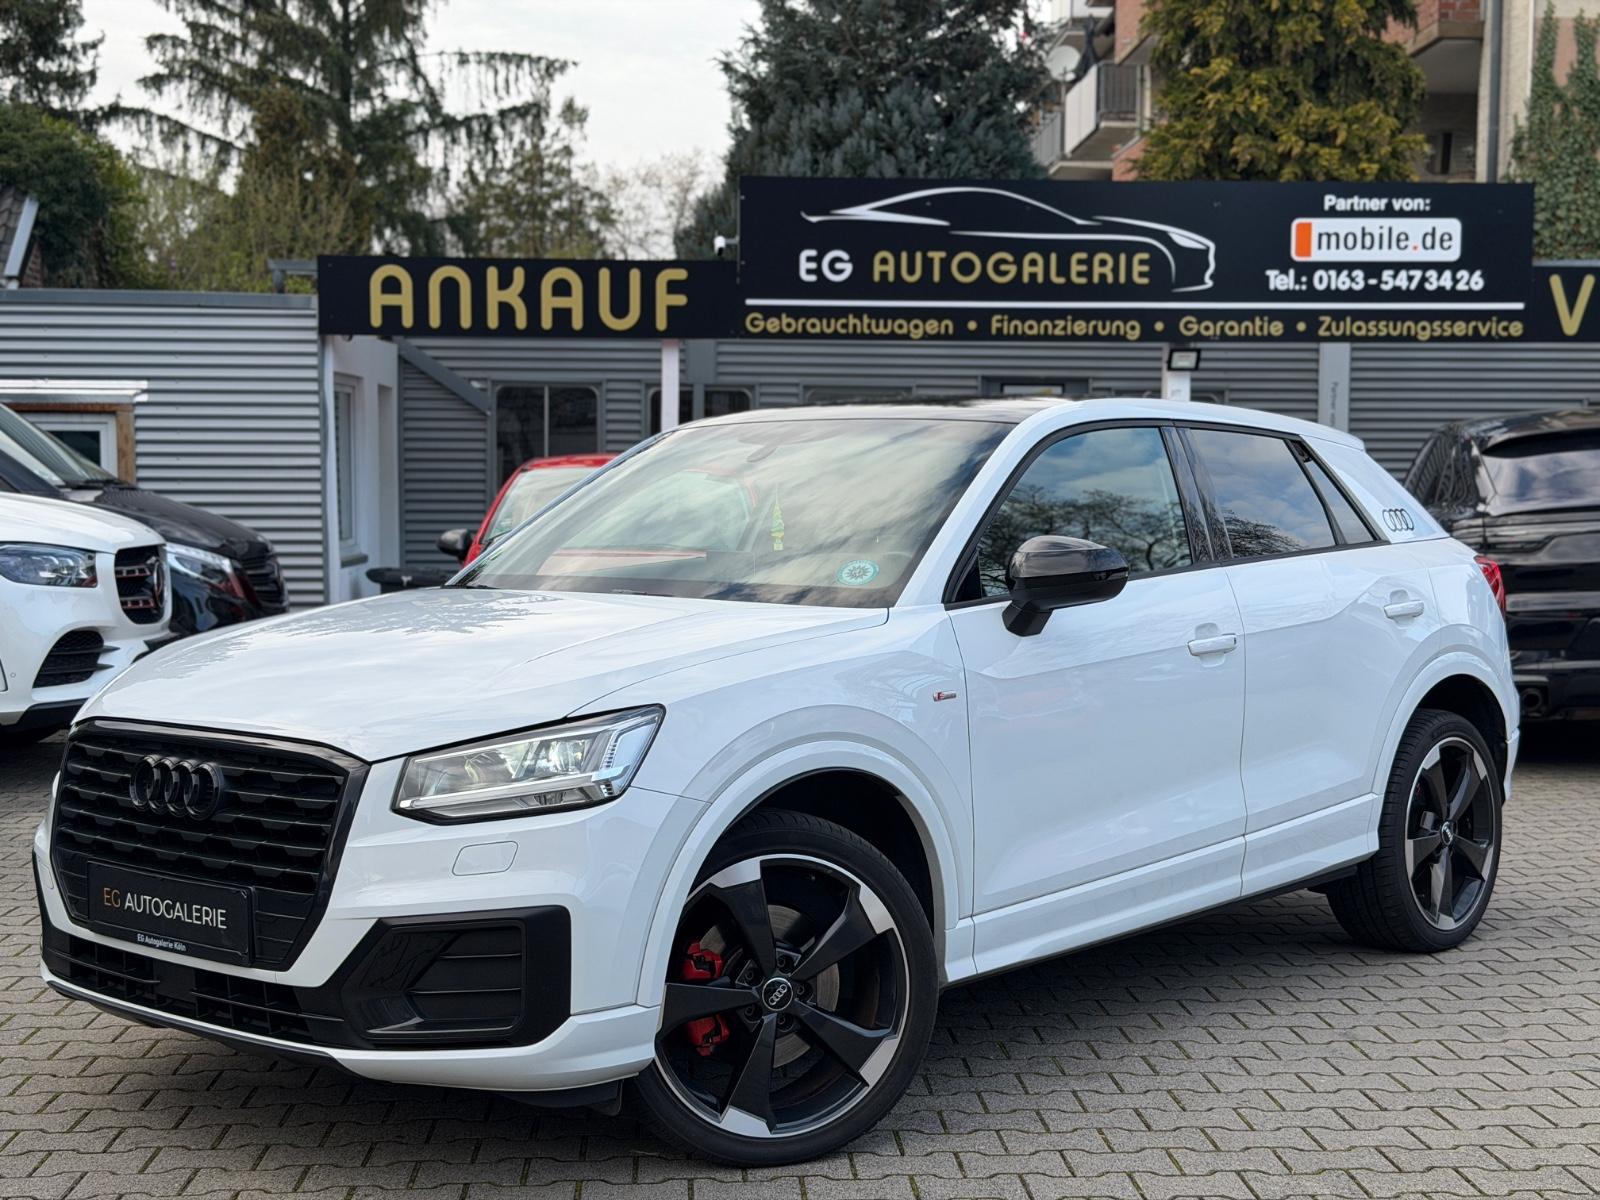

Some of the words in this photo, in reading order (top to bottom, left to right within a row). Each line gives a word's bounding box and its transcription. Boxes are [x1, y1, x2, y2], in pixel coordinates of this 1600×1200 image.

[1323, 194, 1388, 212] Partner
[1392, 197, 1431, 212] von:
[1317, 225, 1454, 251] mobile.de
[798, 249, 854, 282] EG
[873, 250, 1151, 285] AUTOGALERIE
[1265, 268, 1308, 292] Tel.:
[369, 263, 689, 332] ANKAUF
[1548, 273, 1596, 337] V
[744, 312, 954, 340] Gebrauchtwagen
[990, 314, 1141, 341] Finanzierung
[1178, 315, 1285, 337] Garantie
[1317, 315, 1524, 341] Zulassungsservice
[103, 887, 121, 908] EG
[124, 892, 227, 929] AUTOGALERIE
[137, 933, 145, 942] EG
[145, 935, 174, 948] Autogalerie
